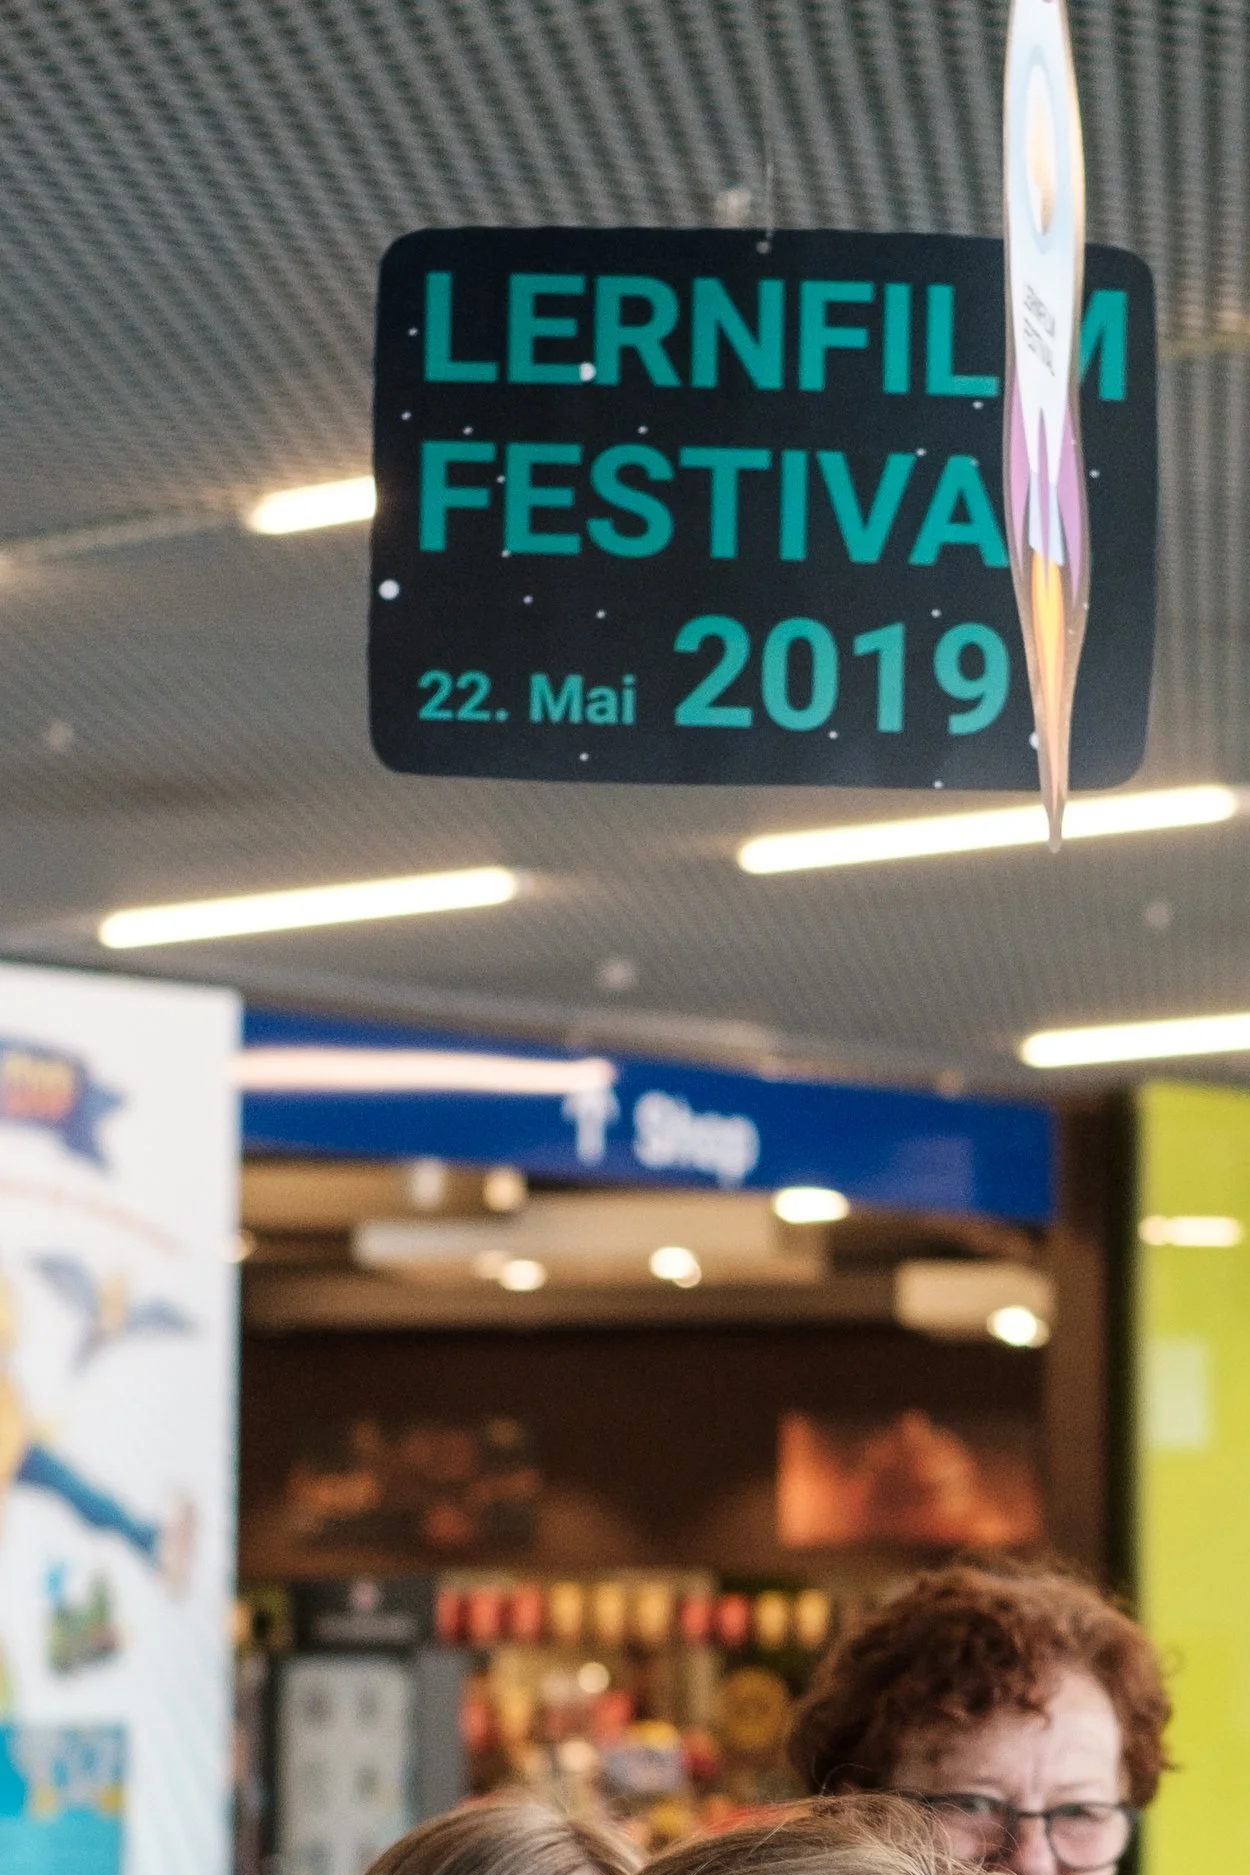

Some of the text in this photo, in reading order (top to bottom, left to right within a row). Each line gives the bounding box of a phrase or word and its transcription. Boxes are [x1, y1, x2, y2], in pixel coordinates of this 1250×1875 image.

[418, 440, 1011, 569] FESTIVA
[418, 613, 1012, 737] 22. Mai 2019
[634, 1091, 761, 1190] Shop
